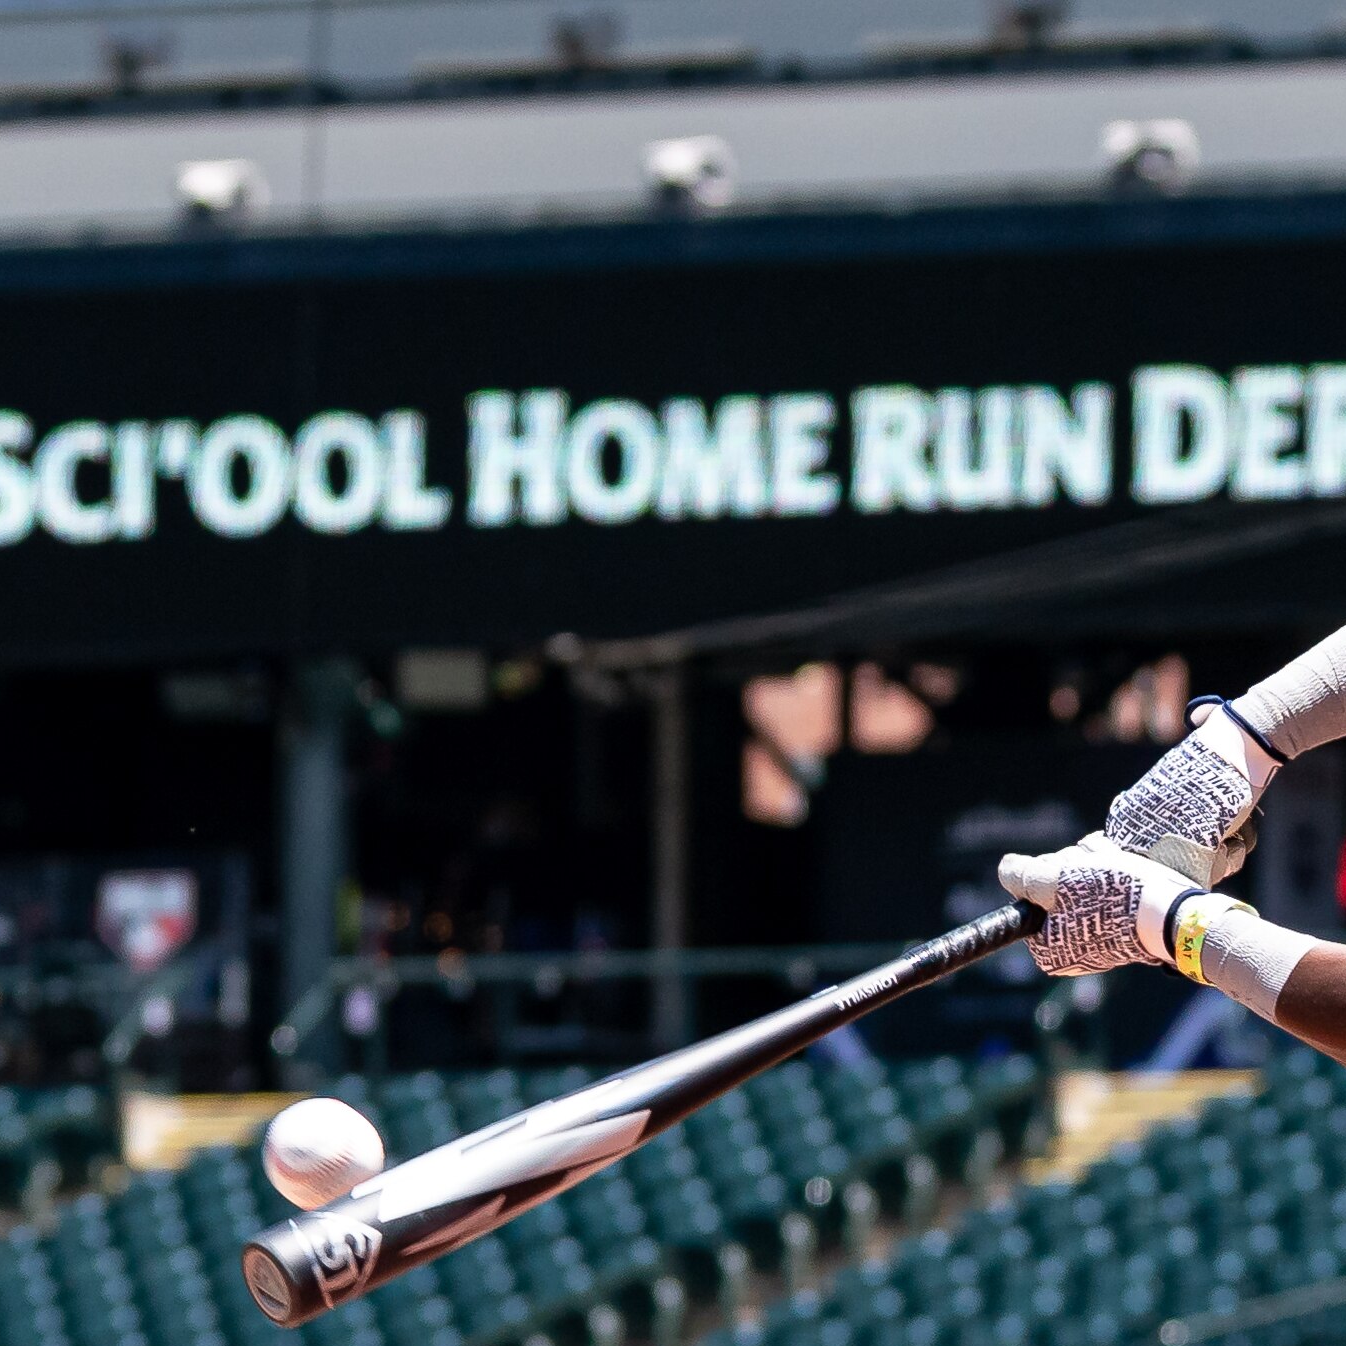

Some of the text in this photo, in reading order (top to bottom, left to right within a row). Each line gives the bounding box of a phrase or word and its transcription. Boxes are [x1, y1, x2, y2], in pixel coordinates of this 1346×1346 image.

[466, 388, 842, 528] HOME
[849, 383, 1115, 513] RUN
[1196, 764, 1241, 807] SMILE
[1158, 786, 1210, 832] BREAKING
